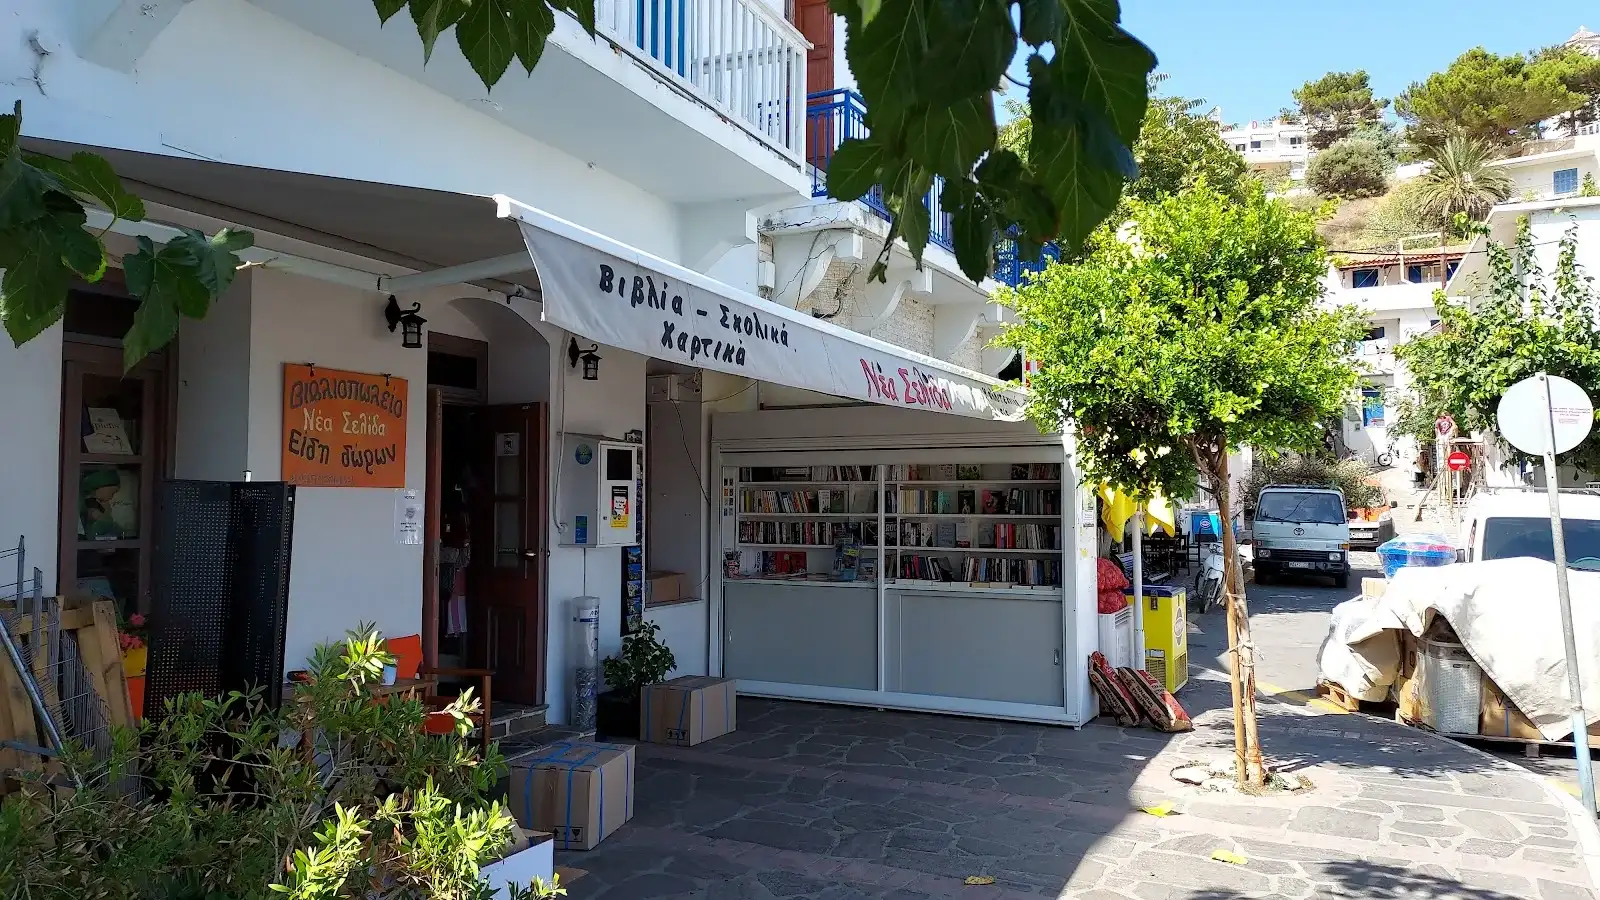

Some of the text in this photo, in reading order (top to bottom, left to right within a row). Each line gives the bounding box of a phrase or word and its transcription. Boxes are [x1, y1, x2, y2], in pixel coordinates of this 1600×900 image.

[599, 264, 683, 317] Βιβλία
[661, 320, 746, 366] Χαρτικά
[290, 378, 403, 418] Βιβλιοπωλείο
[860, 358, 899, 402] Νέα
[303, 407, 386, 436] Νέα Σελίδα
[288, 428, 396, 475] Είδη δώρων
